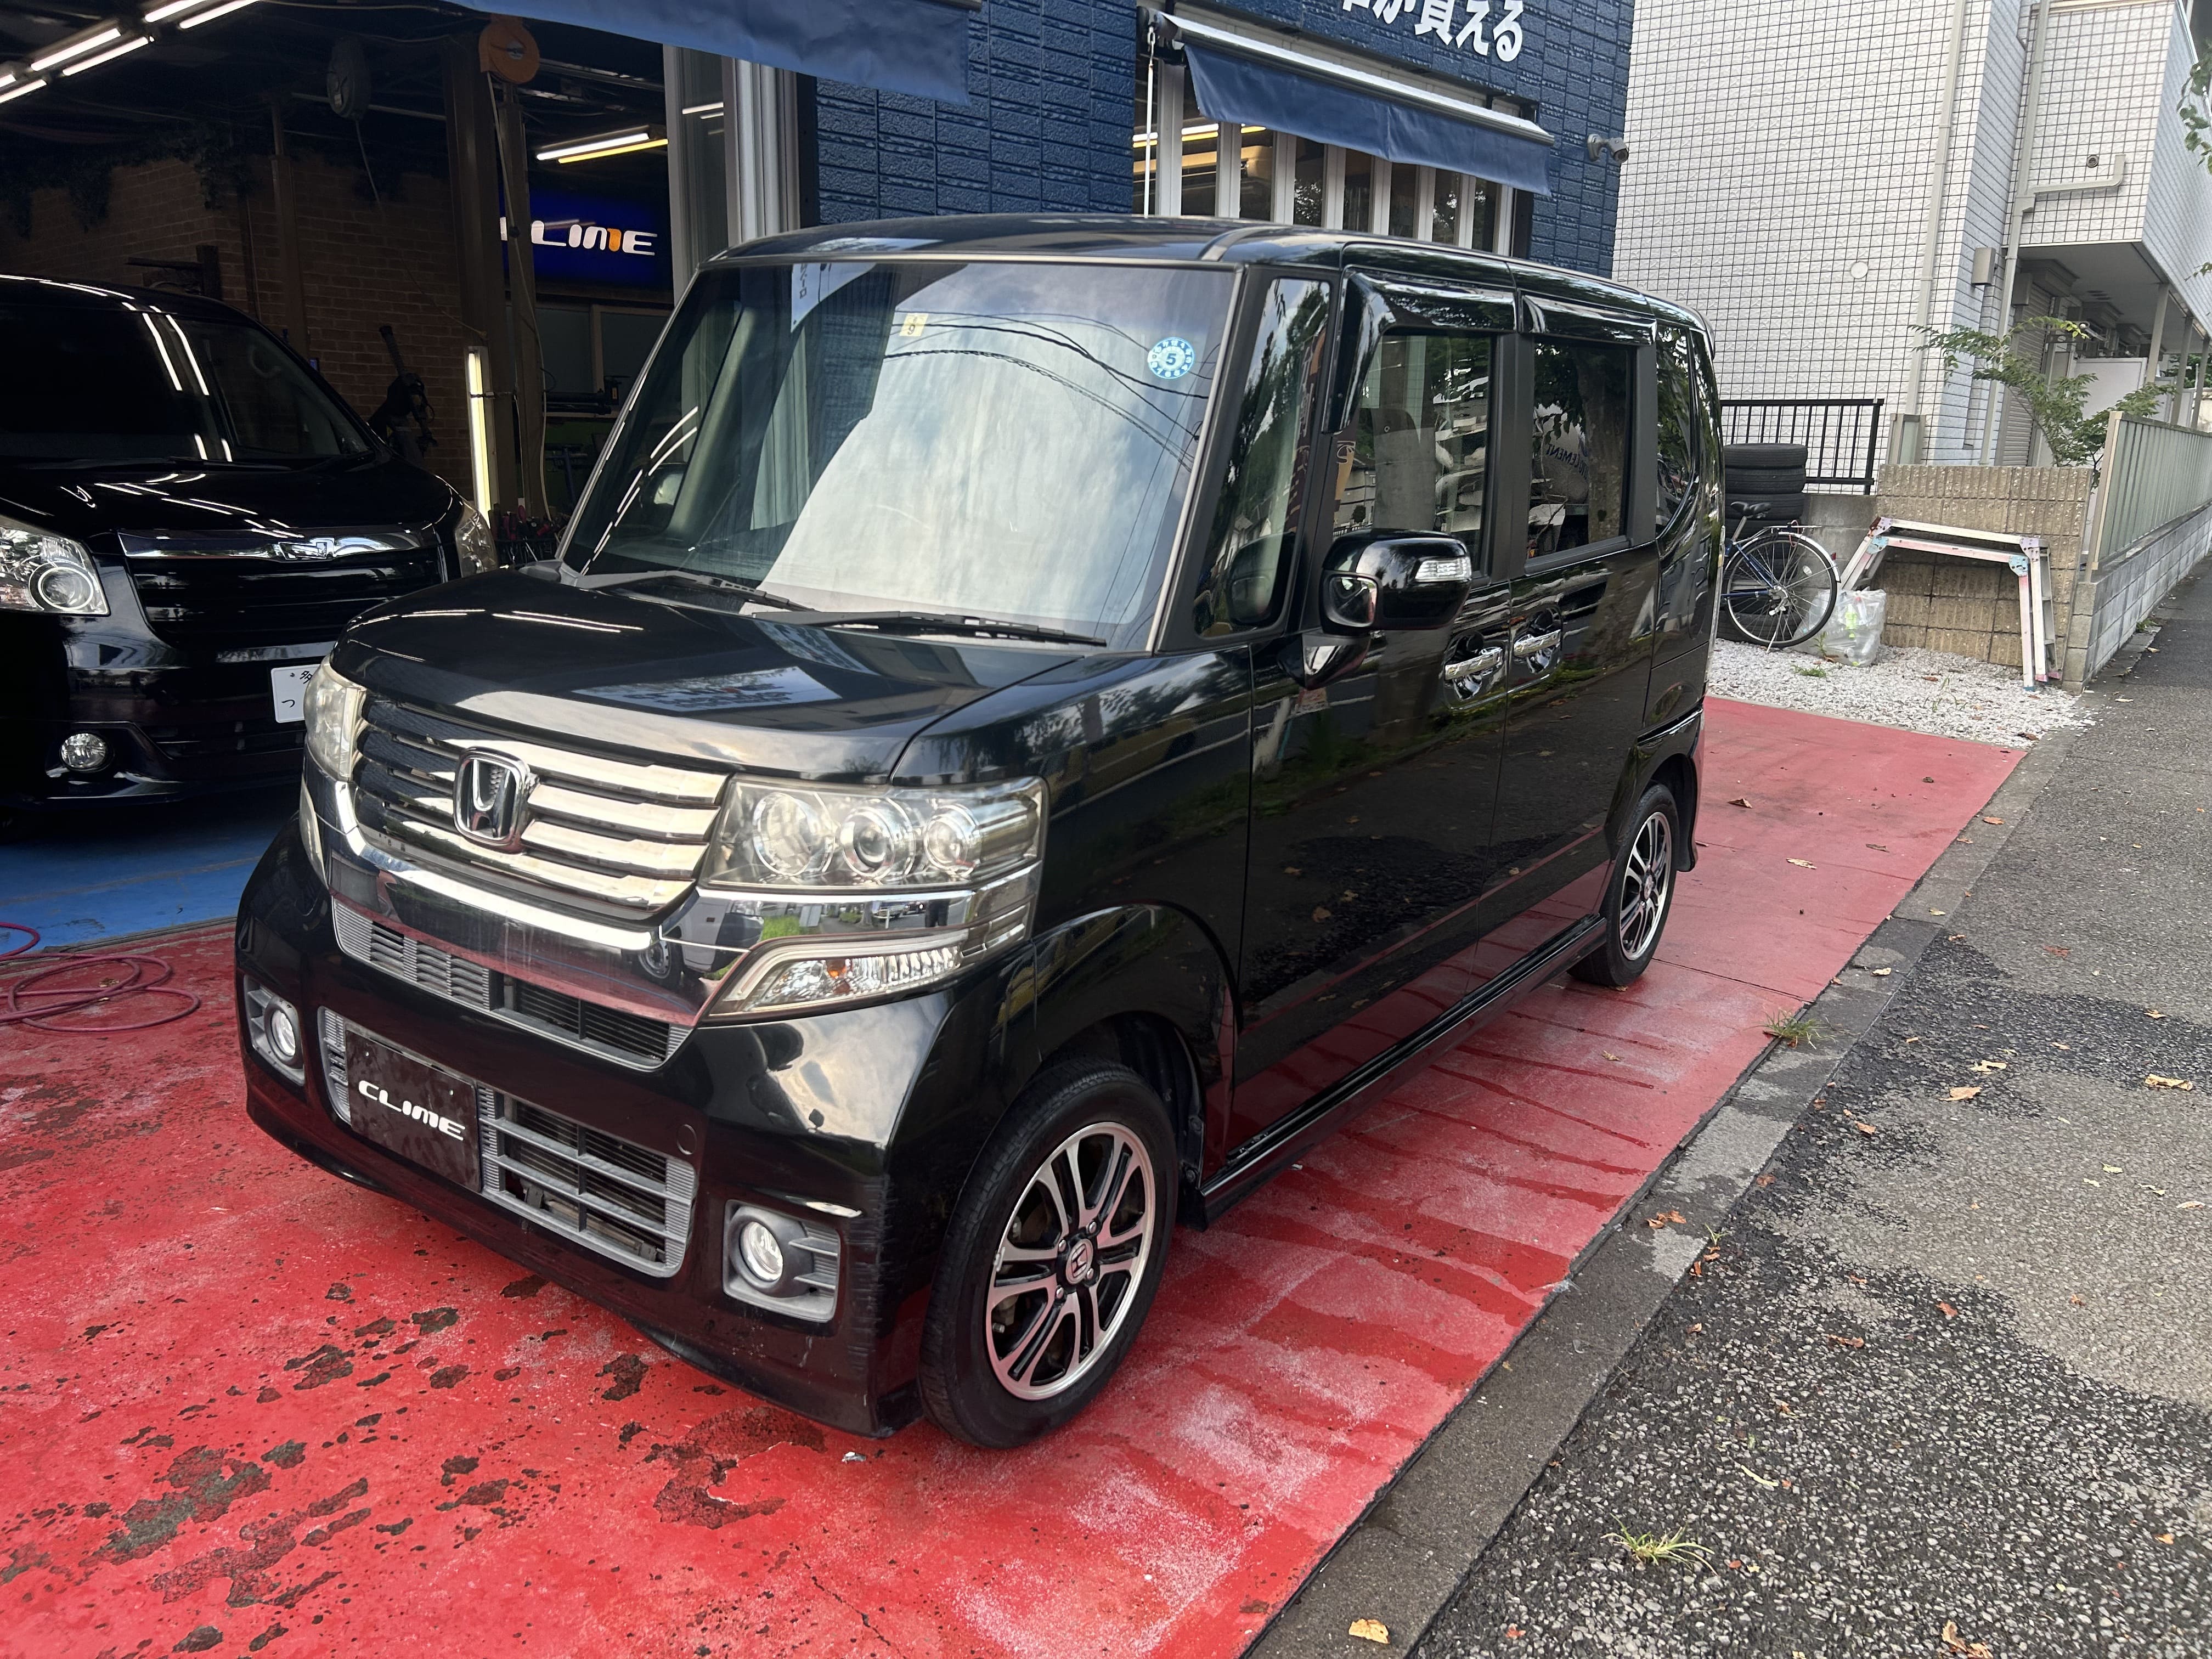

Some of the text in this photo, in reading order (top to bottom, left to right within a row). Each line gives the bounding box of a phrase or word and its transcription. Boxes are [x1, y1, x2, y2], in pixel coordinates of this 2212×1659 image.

[1342, 0, 1523, 62] 買える
[500, 216, 658, 256] LIME
[1166, 353, 1176, 365] 5
[281, 699, 295, 708] つ
